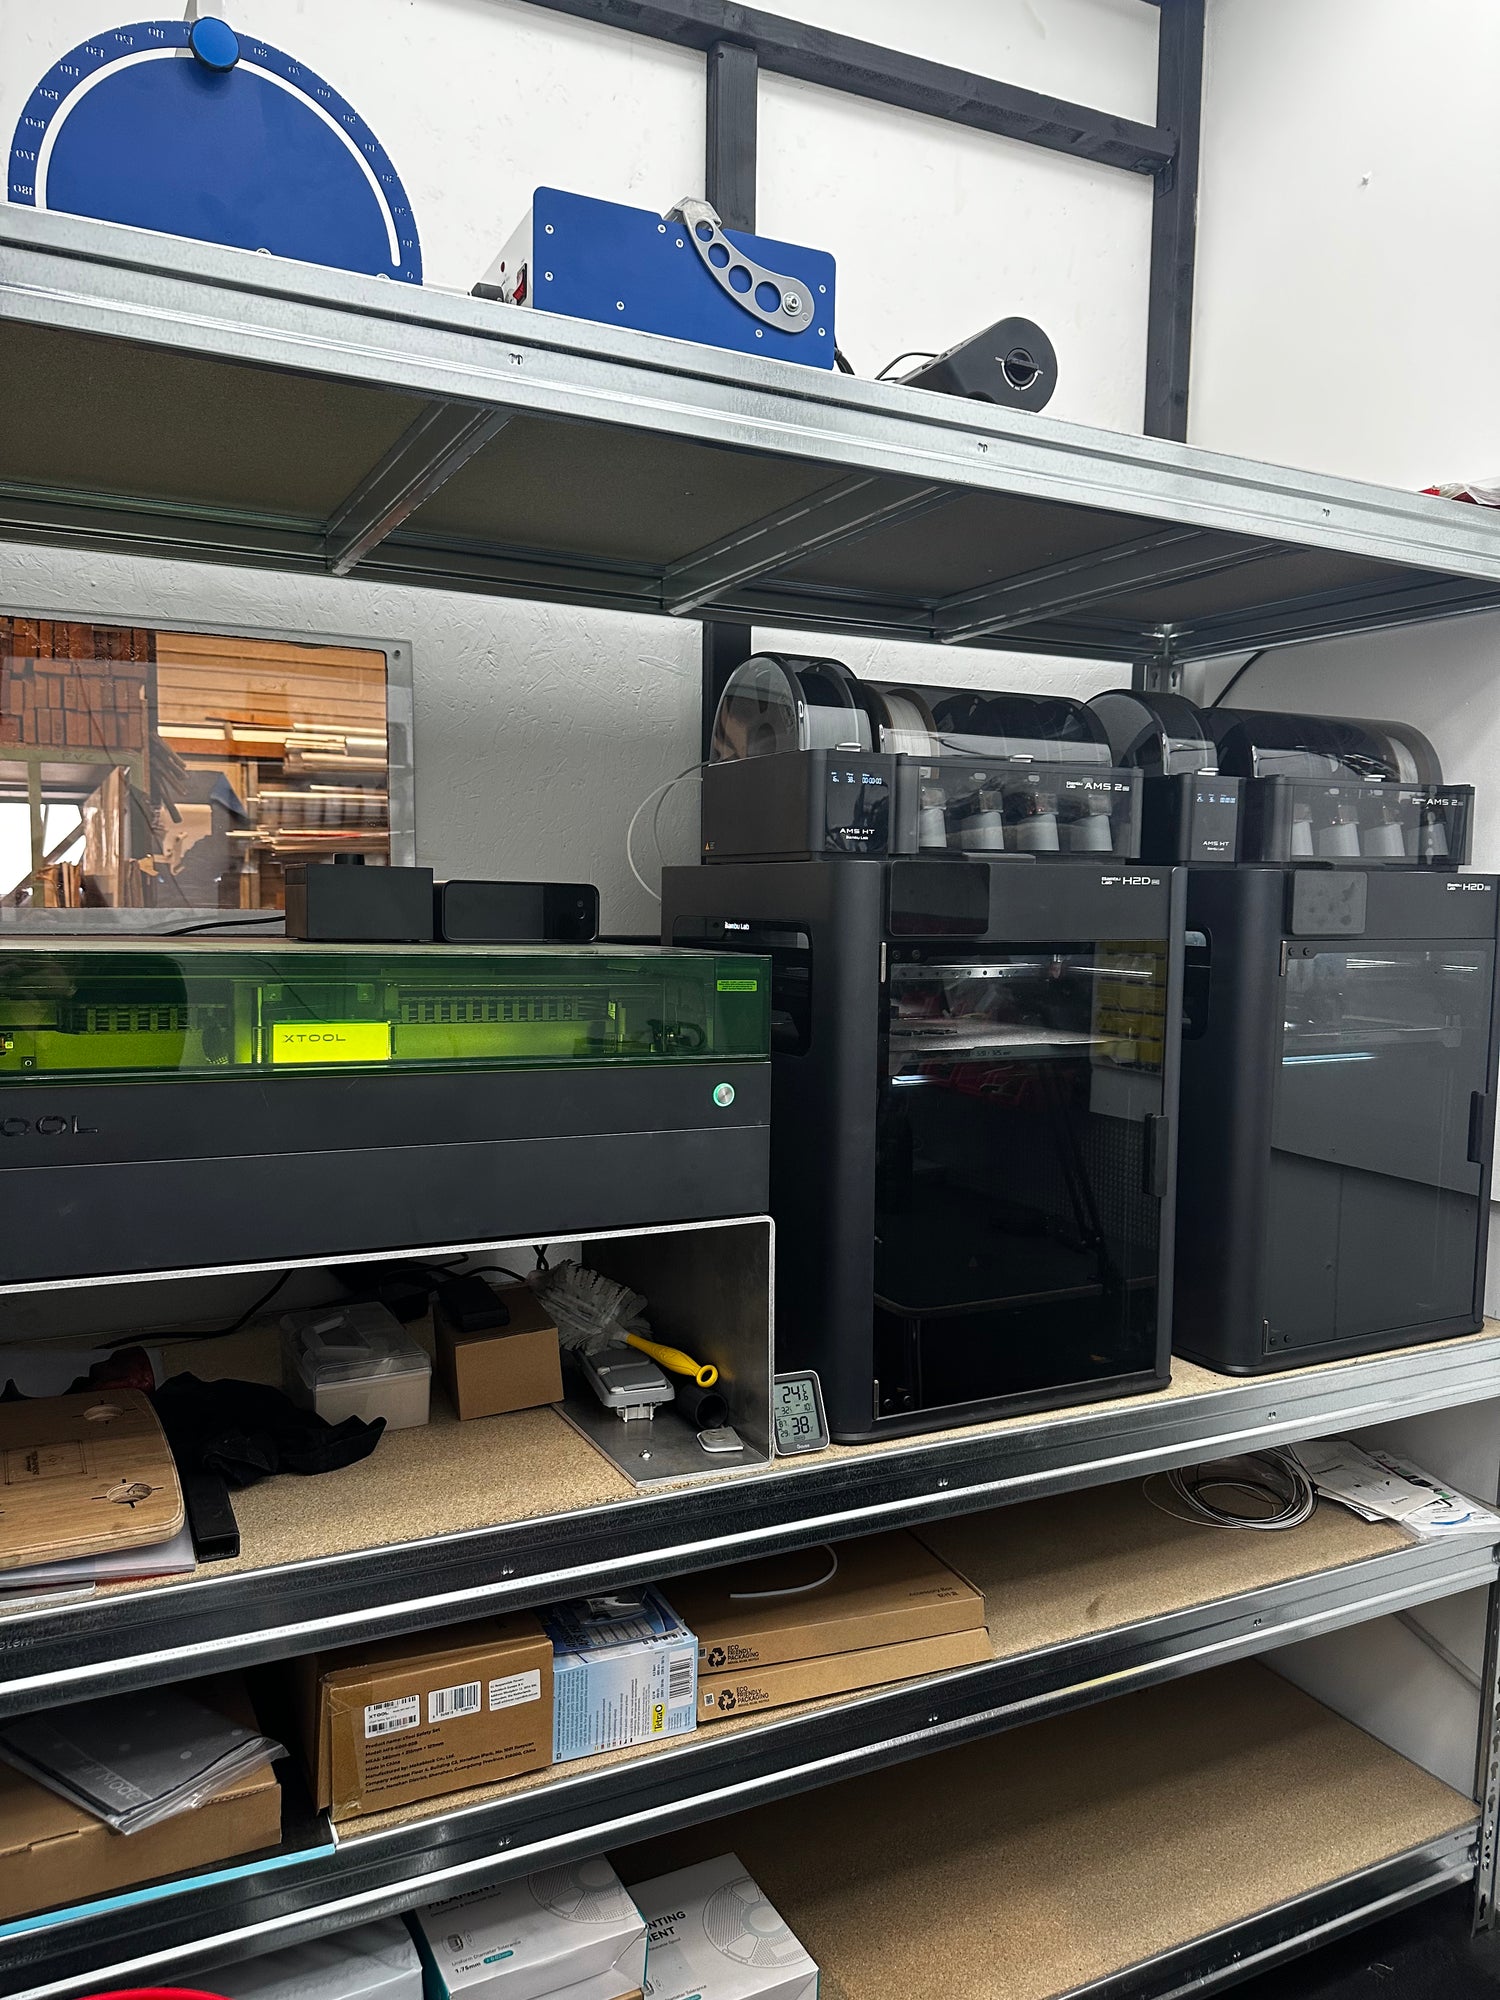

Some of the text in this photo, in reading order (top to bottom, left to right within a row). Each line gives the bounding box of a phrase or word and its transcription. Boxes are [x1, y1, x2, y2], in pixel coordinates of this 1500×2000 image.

[1084, 782, 1112, 791] AMS
[1114, 783, 1123, 791] 2
[1426, 798, 1449, 806] AMS
[1122, 876, 1151, 885] H2D
[1462, 883, 1484, 891] H2D
[740, 923, 750, 931] Lab
[284, 1033, 346, 1043] XTOOL
[791, 1416, 810, 1436] 38
[727, 1647, 753, 1655] FRIENDLY
[728, 1651, 760, 1660] PACKAGING
[737, 1688, 762, 1697] FRIENDLY
[737, 1692, 769, 1703] PACKAGING
[654, 1712, 663, 1731] Tetra
[365, 1741, 386, 1749] Product
[416, 1730, 432, 1738] Safety
[365, 1778, 389, 1787] Company
[647, 1911, 686, 1930] NTING
[648, 1926, 675, 1942] ENT
[451, 1940, 522, 1966] Uniform Diameter Tolerance
[454, 1962, 482, 1974] 1.75mm
